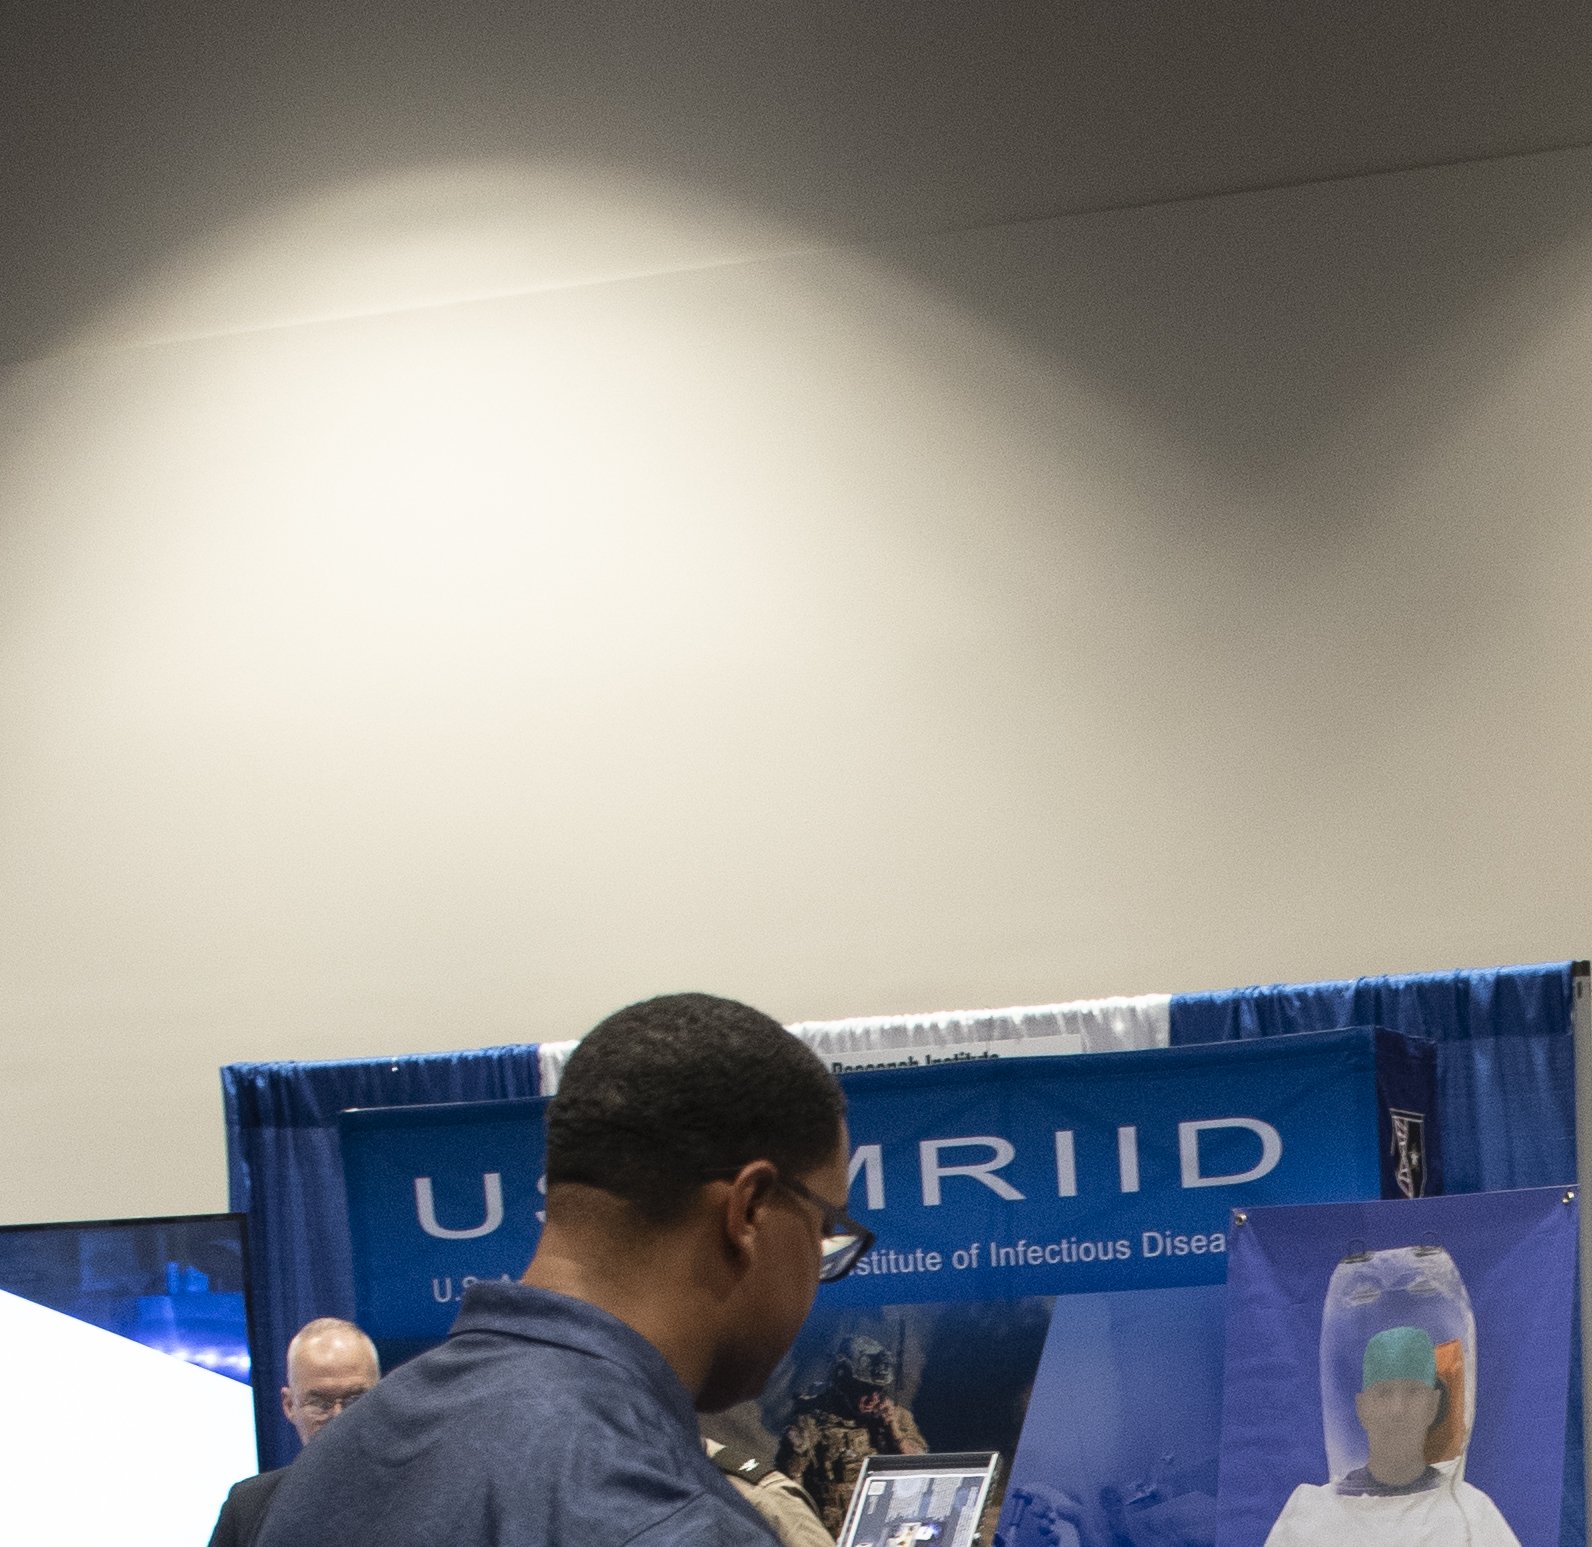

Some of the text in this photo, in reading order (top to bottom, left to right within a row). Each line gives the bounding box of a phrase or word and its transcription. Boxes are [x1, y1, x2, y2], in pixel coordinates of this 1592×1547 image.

[850, 1247, 943, 1277] stitute
[952, 1242, 981, 1270] of
[989, 1236, 1132, 1267] Infectious
[1141, 1230, 1227, 1258] Disea
